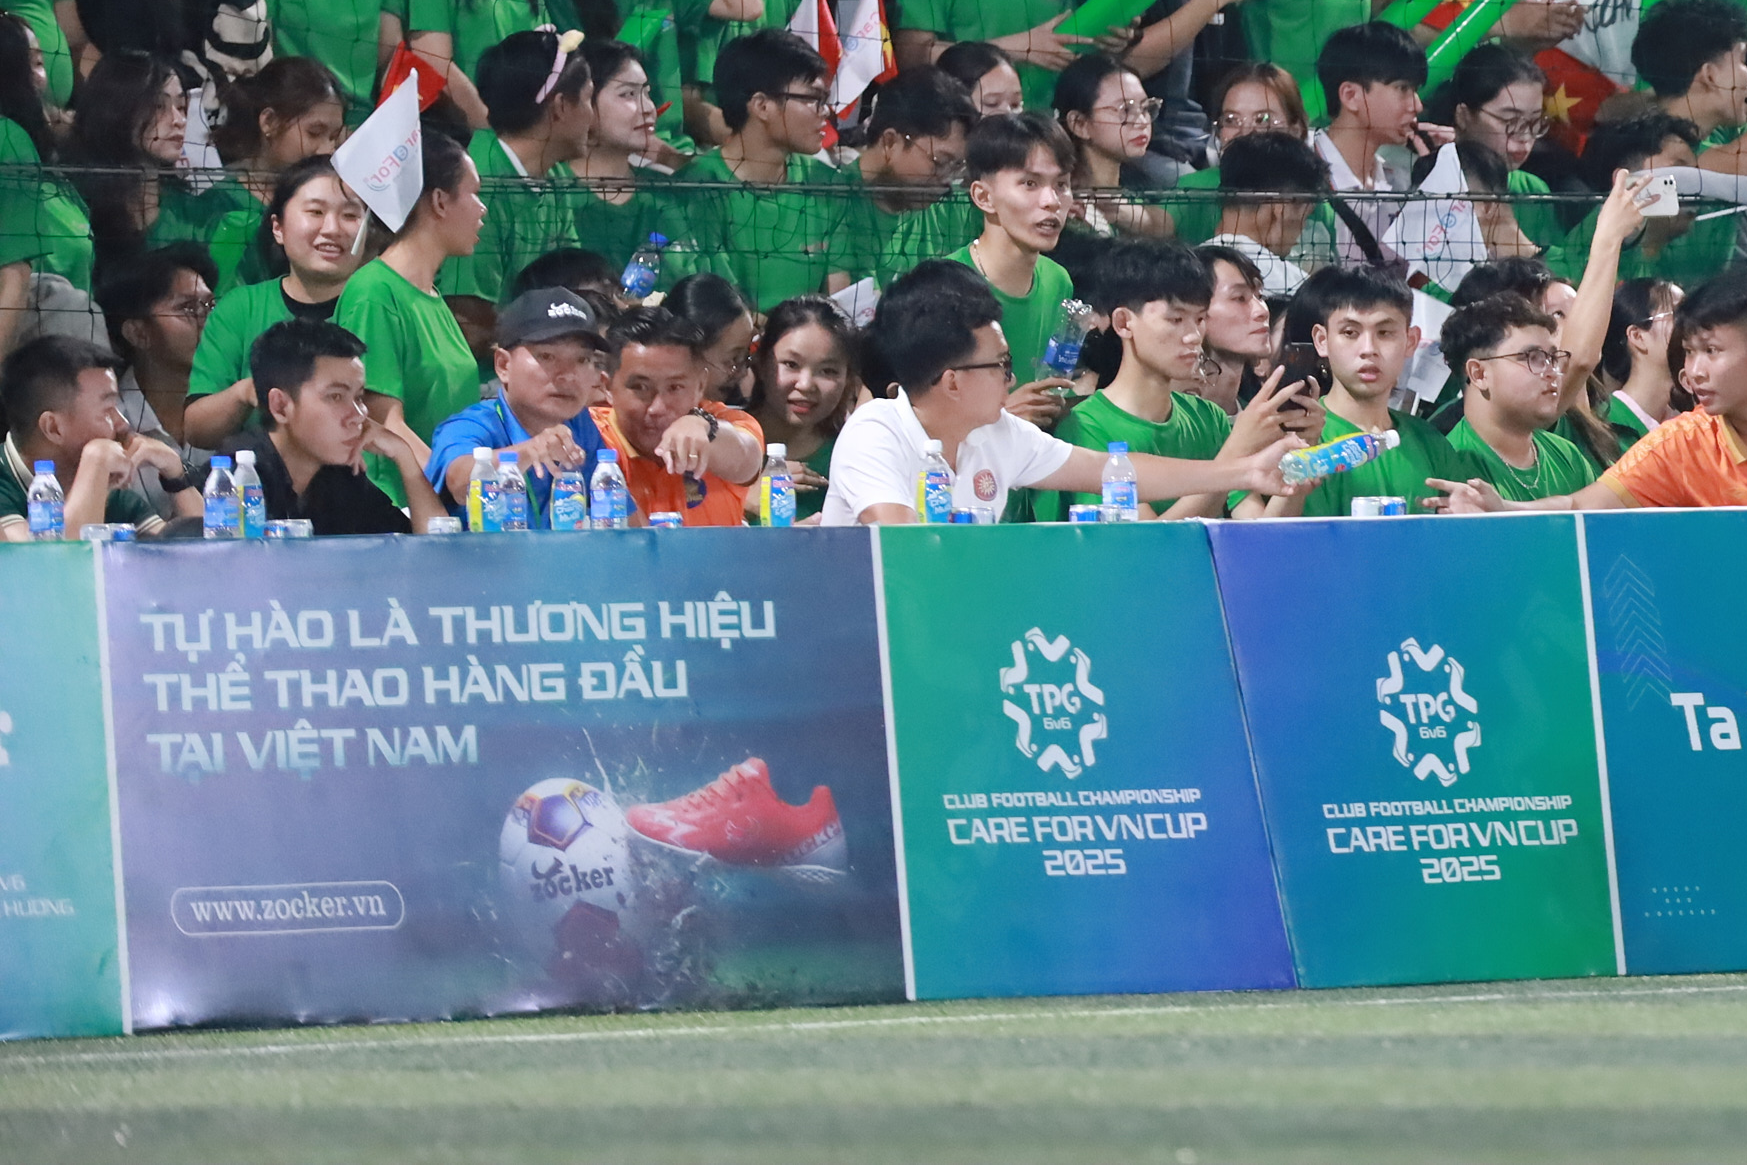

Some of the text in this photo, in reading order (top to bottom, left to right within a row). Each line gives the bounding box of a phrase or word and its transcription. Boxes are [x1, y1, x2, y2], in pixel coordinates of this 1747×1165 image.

[140, 590, 776, 664] TỰ HÀO LÀ THƯƠNG HIỆU
[143, 645, 689, 712] THỂ THAO HÀNG ĐẦU
[1023, 683, 1081, 715] TPG
[1399, 692, 1456, 725] TPG
[1670, 692, 1742, 751] Ta
[146, 718, 478, 783] TẠI VIỆT NAM
[943, 788, 1202, 810] CLUB FOOTBALL CHAMPIONSHIP
[1322, 795, 1572, 819] CLUB FOOTBALL CHAMPIONSHIP
[946, 817, 1030, 845] CARE
[1326, 826, 1408, 854] CARE
[1042, 849, 1127, 876] 2025
[1419, 855, 1502, 884] 2025
[530, 863, 615, 903] zocker
[190, 890, 387, 923] www.zocker.vn
